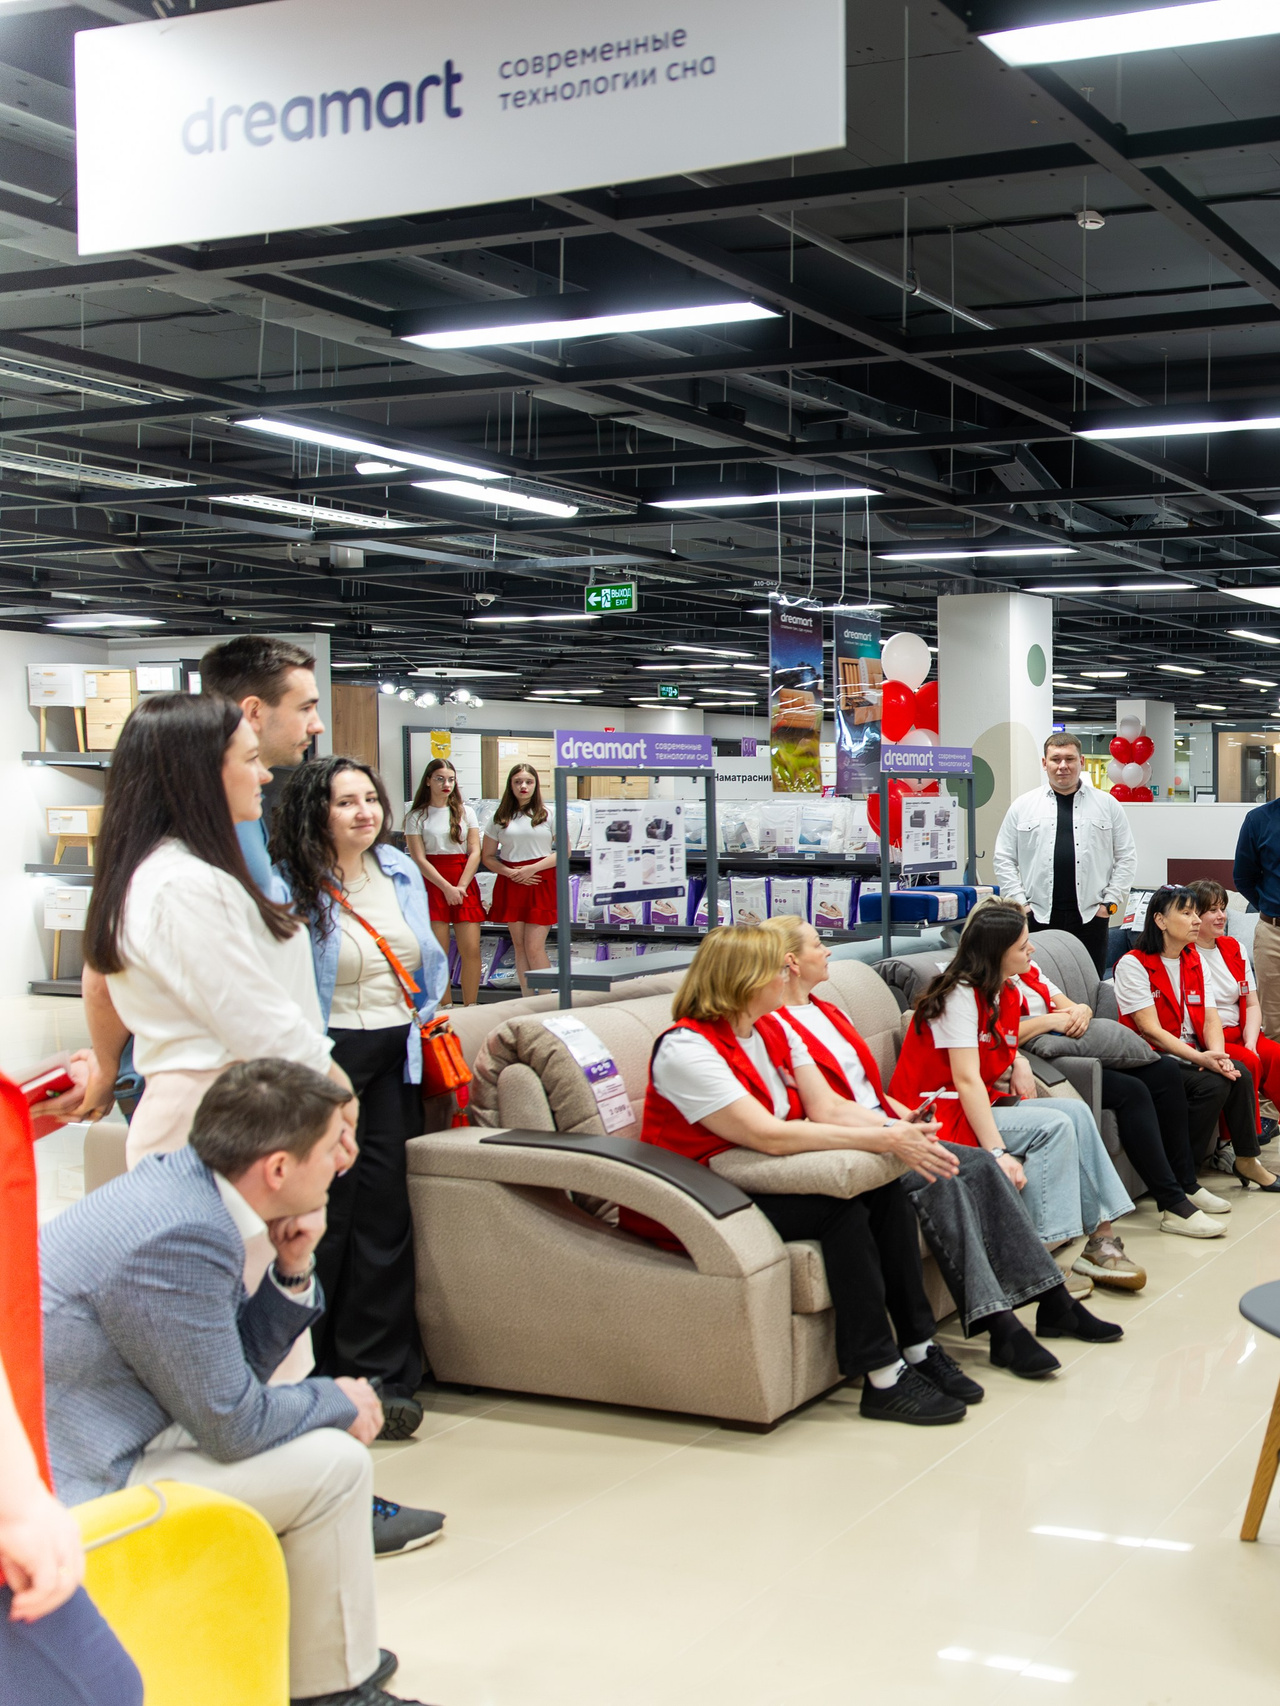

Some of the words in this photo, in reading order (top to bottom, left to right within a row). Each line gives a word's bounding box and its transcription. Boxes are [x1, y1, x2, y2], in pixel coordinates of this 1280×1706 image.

[498, 26, 688, 80] современные
[498, 64, 658, 110] технологии
[665, 53, 717, 82] сна
[181, 58, 463, 155] dreamart
[611, 587, 632, 598] ВЫХОД
[615, 598, 628, 606] EXIT
[780, 612, 813, 627] dreamart
[843, 628, 872, 642] dreamart
[561, 737, 648, 760] dreamart
[655, 742, 702, 752] современные
[655, 752, 696, 760] технологии
[884, 749, 934, 767] dreamart
